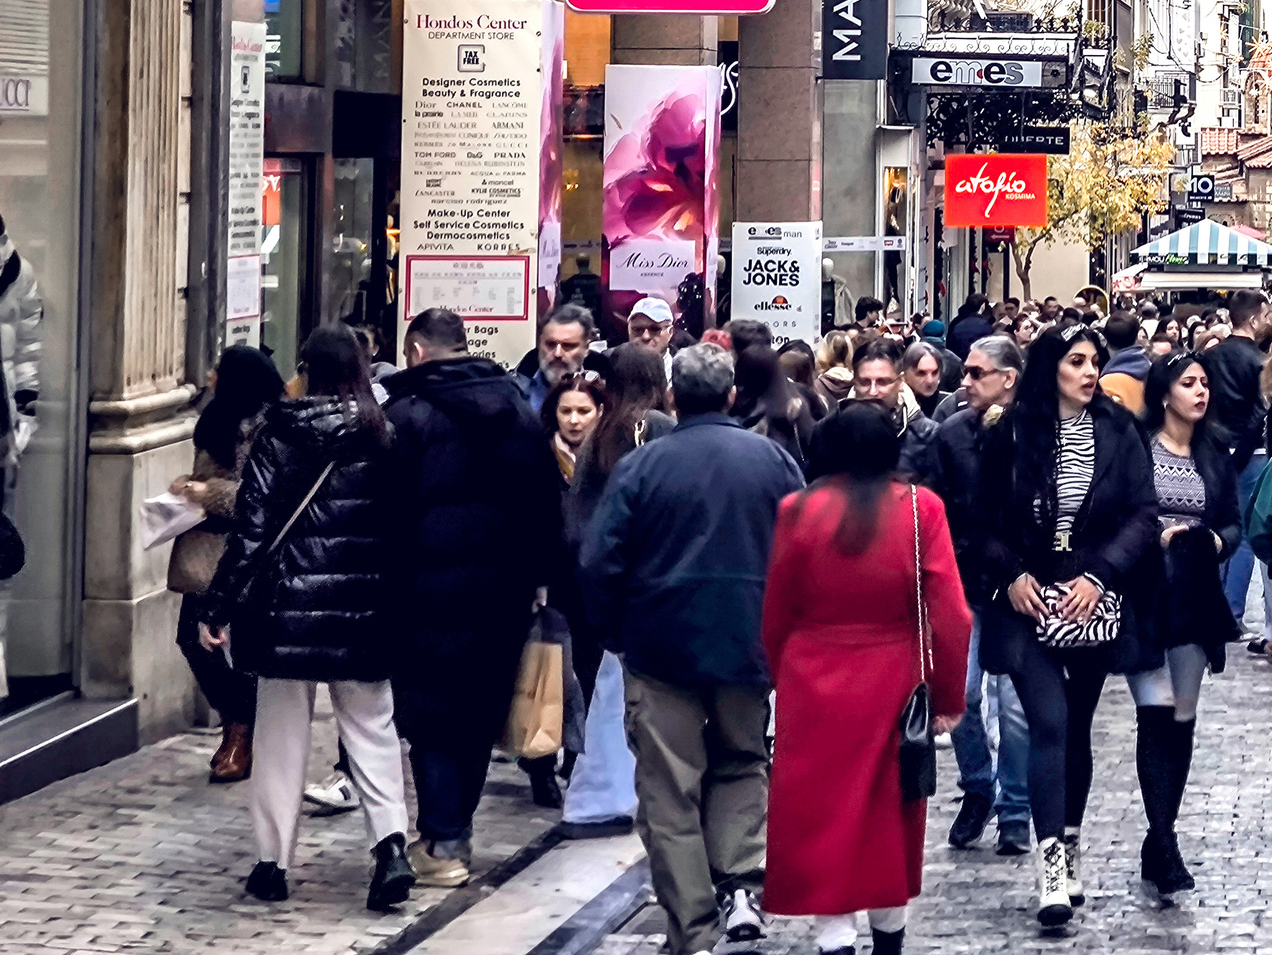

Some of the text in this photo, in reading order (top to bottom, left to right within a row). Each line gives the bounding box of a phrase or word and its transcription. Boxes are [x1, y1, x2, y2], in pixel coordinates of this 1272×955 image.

[416, 14, 528, 30] Hondos Center
[428, 31, 515, 40] DEPARTMENT STORE
[422, 78, 521, 88] Designer Cosmetics
[422, 89, 456, 99] Beauty
[470, 89, 521, 99] Fragrance
[415, 100, 436, 108] Dior
[427, 209, 511, 219] Make-Up Center
[413, 221, 524, 229] Self Service Cosmetics
[426, 232, 510, 240] Dermocosmetics
[477, 243, 521, 251] KORRES
[616, 252, 688, 269] Miss Dior
[743, 273, 800, 287] JONES
[469, 305, 494, 313] Center
[754, 301, 792, 311] ellesse
[474, 325, 499, 336] Bags
